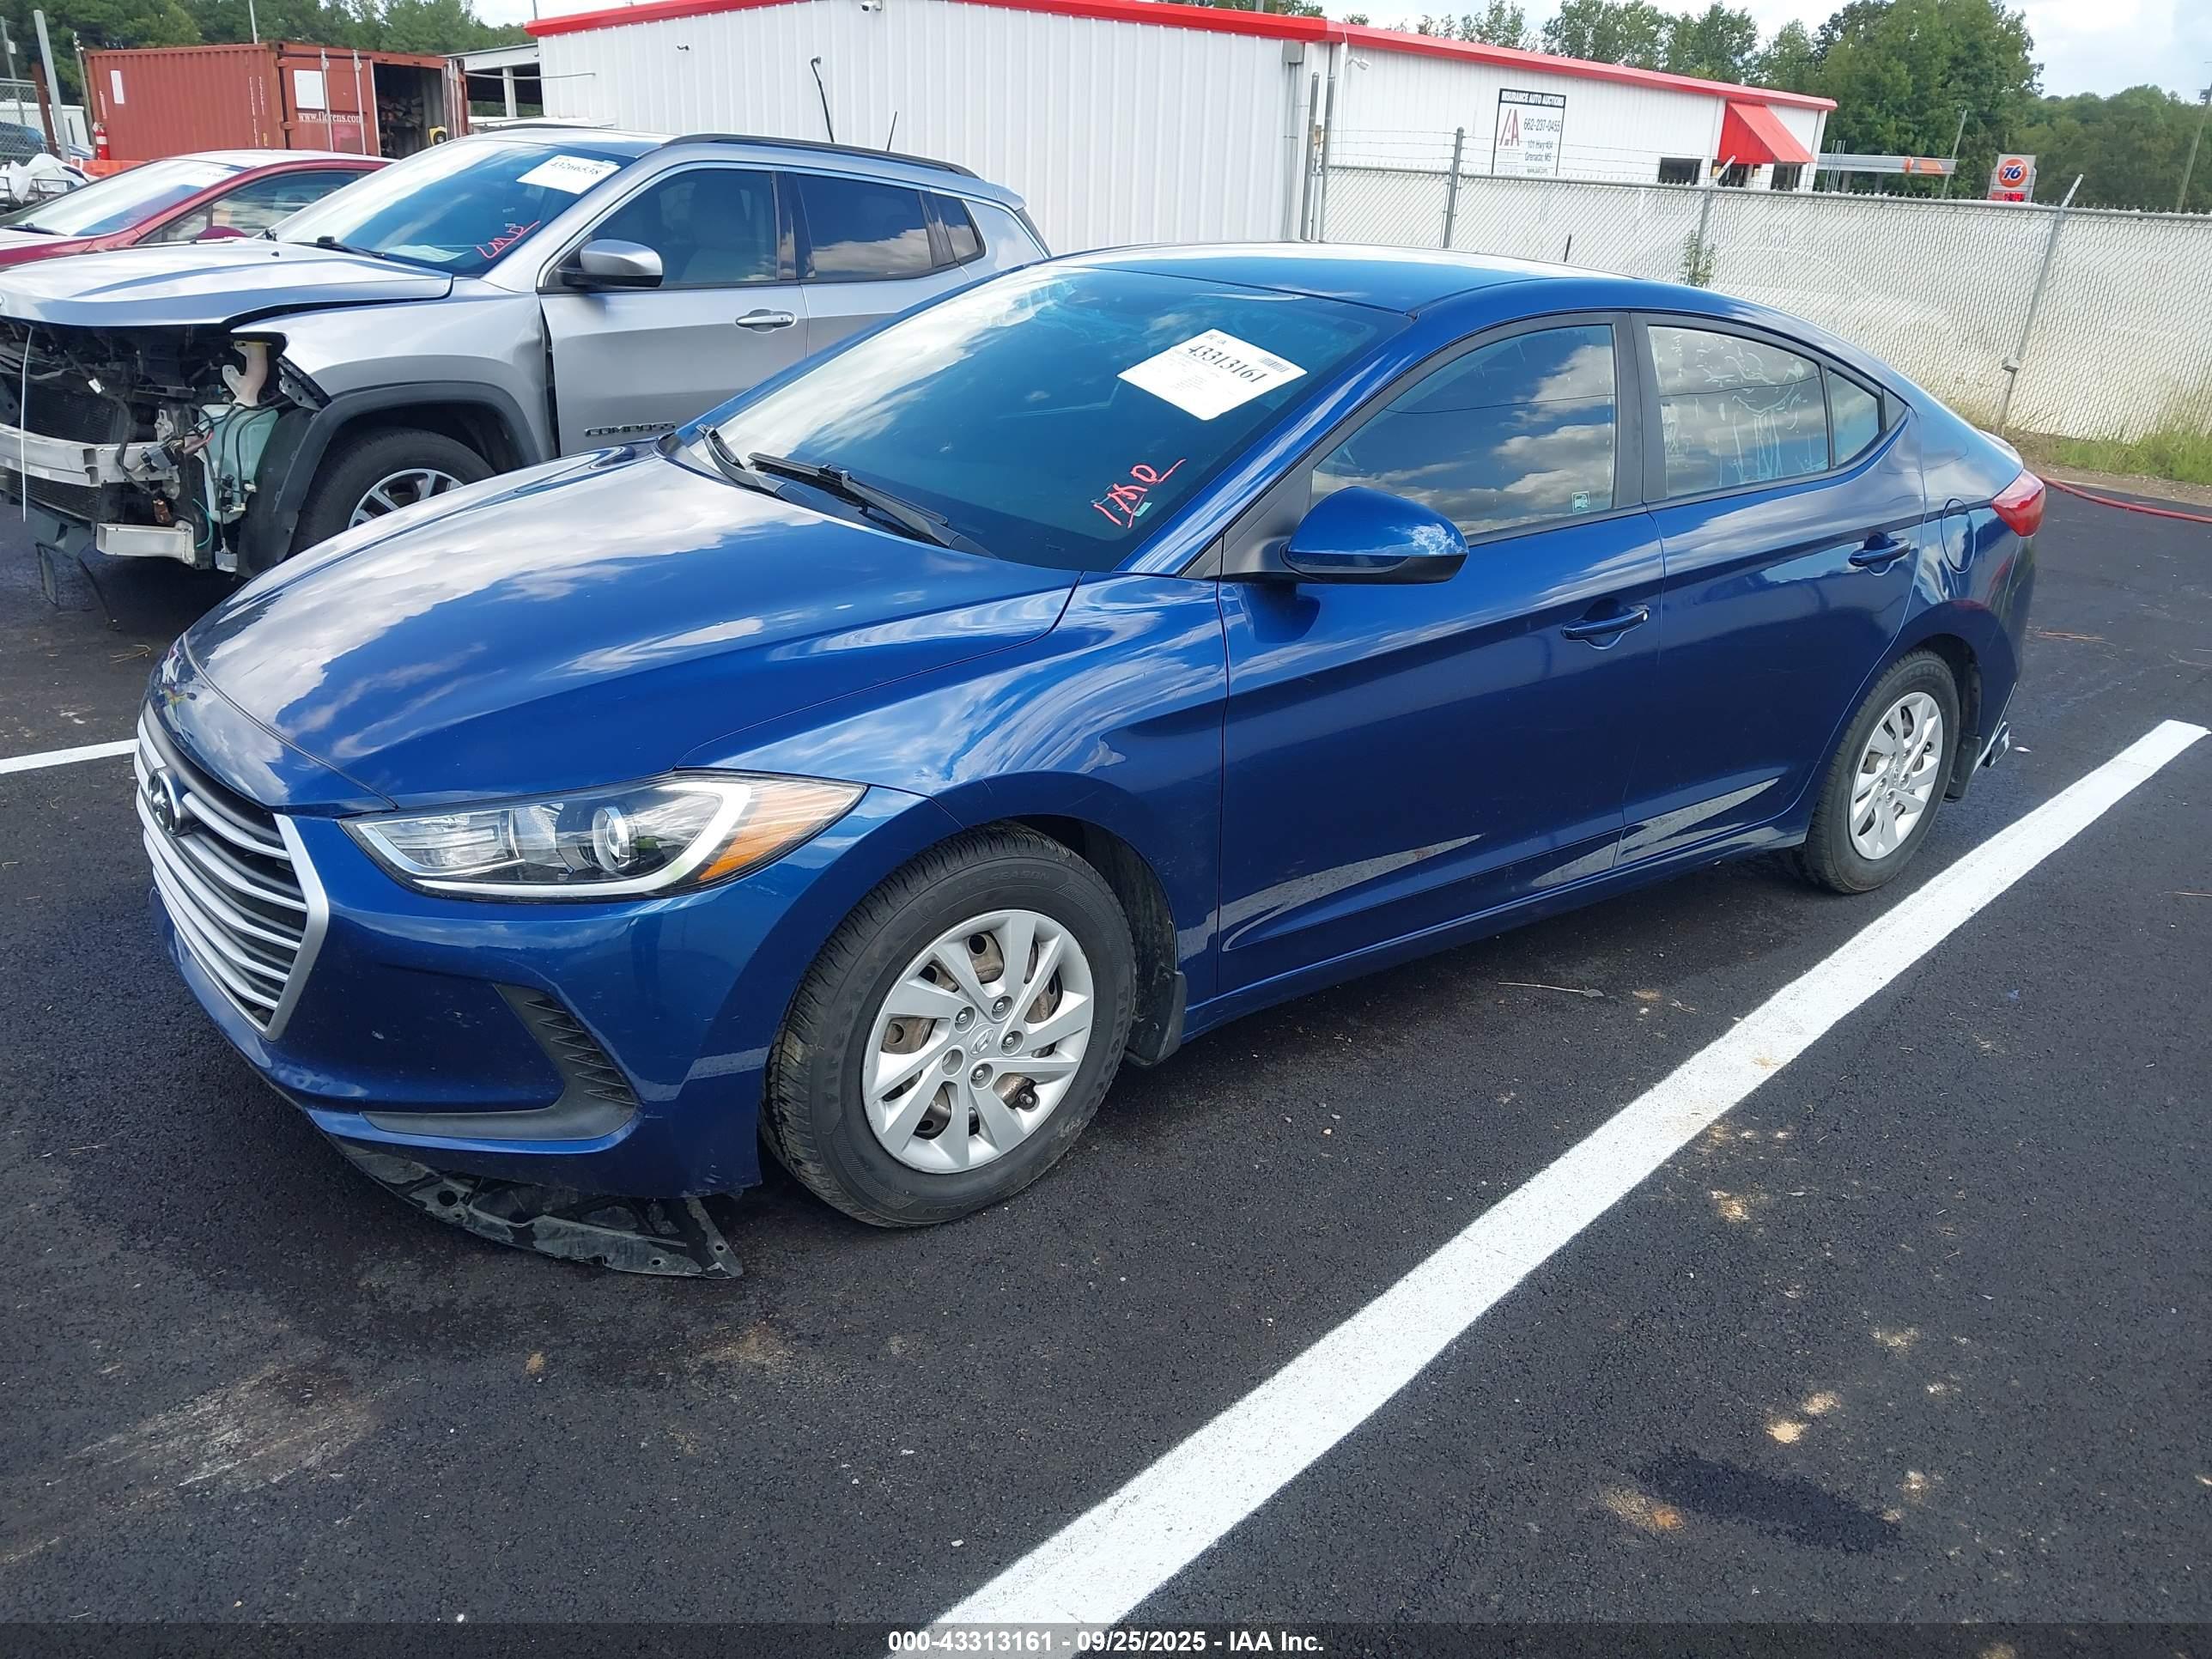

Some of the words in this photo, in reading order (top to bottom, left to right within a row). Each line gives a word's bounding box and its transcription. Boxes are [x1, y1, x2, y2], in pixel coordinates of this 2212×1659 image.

[1528, 94, 1542, 105] AUTO
[2001, 164, 2024, 180] 76
[1188, 343, 1269, 383] 43313161
